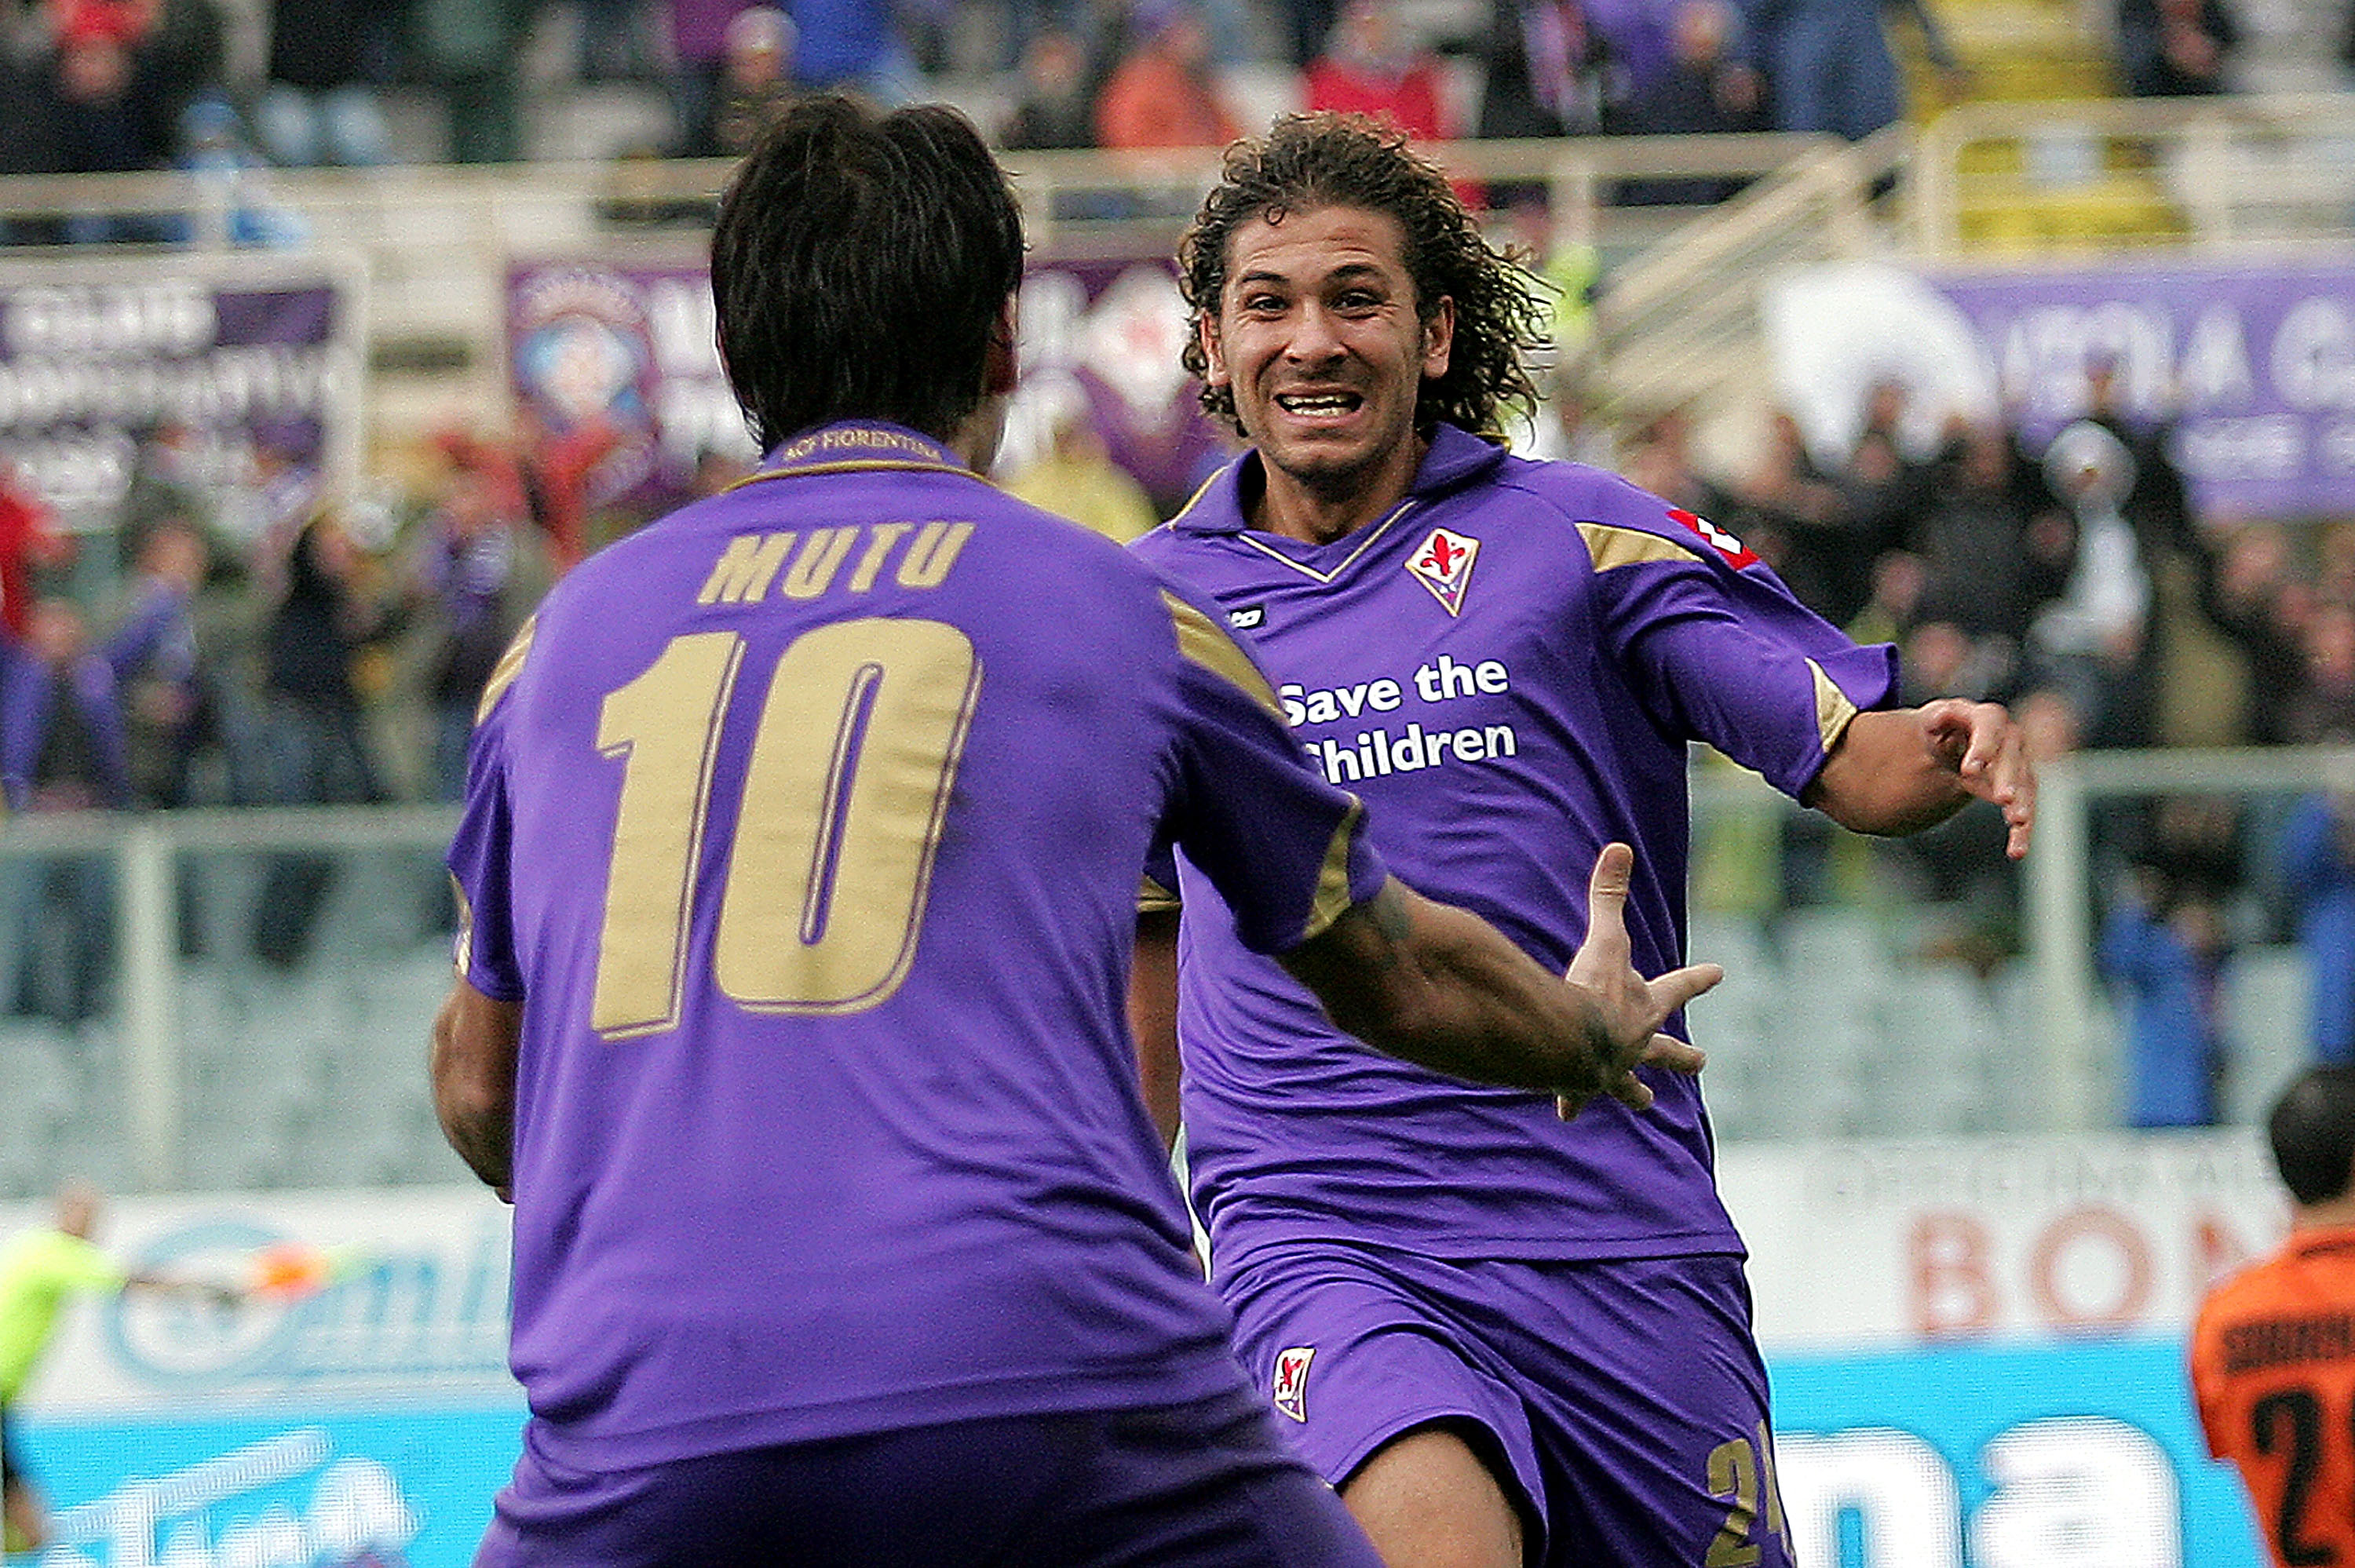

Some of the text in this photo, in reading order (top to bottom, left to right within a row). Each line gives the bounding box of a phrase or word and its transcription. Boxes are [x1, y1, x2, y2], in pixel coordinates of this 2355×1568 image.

[697, 521, 976, 603] MUTU
[1279, 654, 1510, 727] Save the
[592, 617, 983, 1041] 10
[1768, 1417, 2186, 1568] na
[2250, 1389, 2355, 1566] 2
